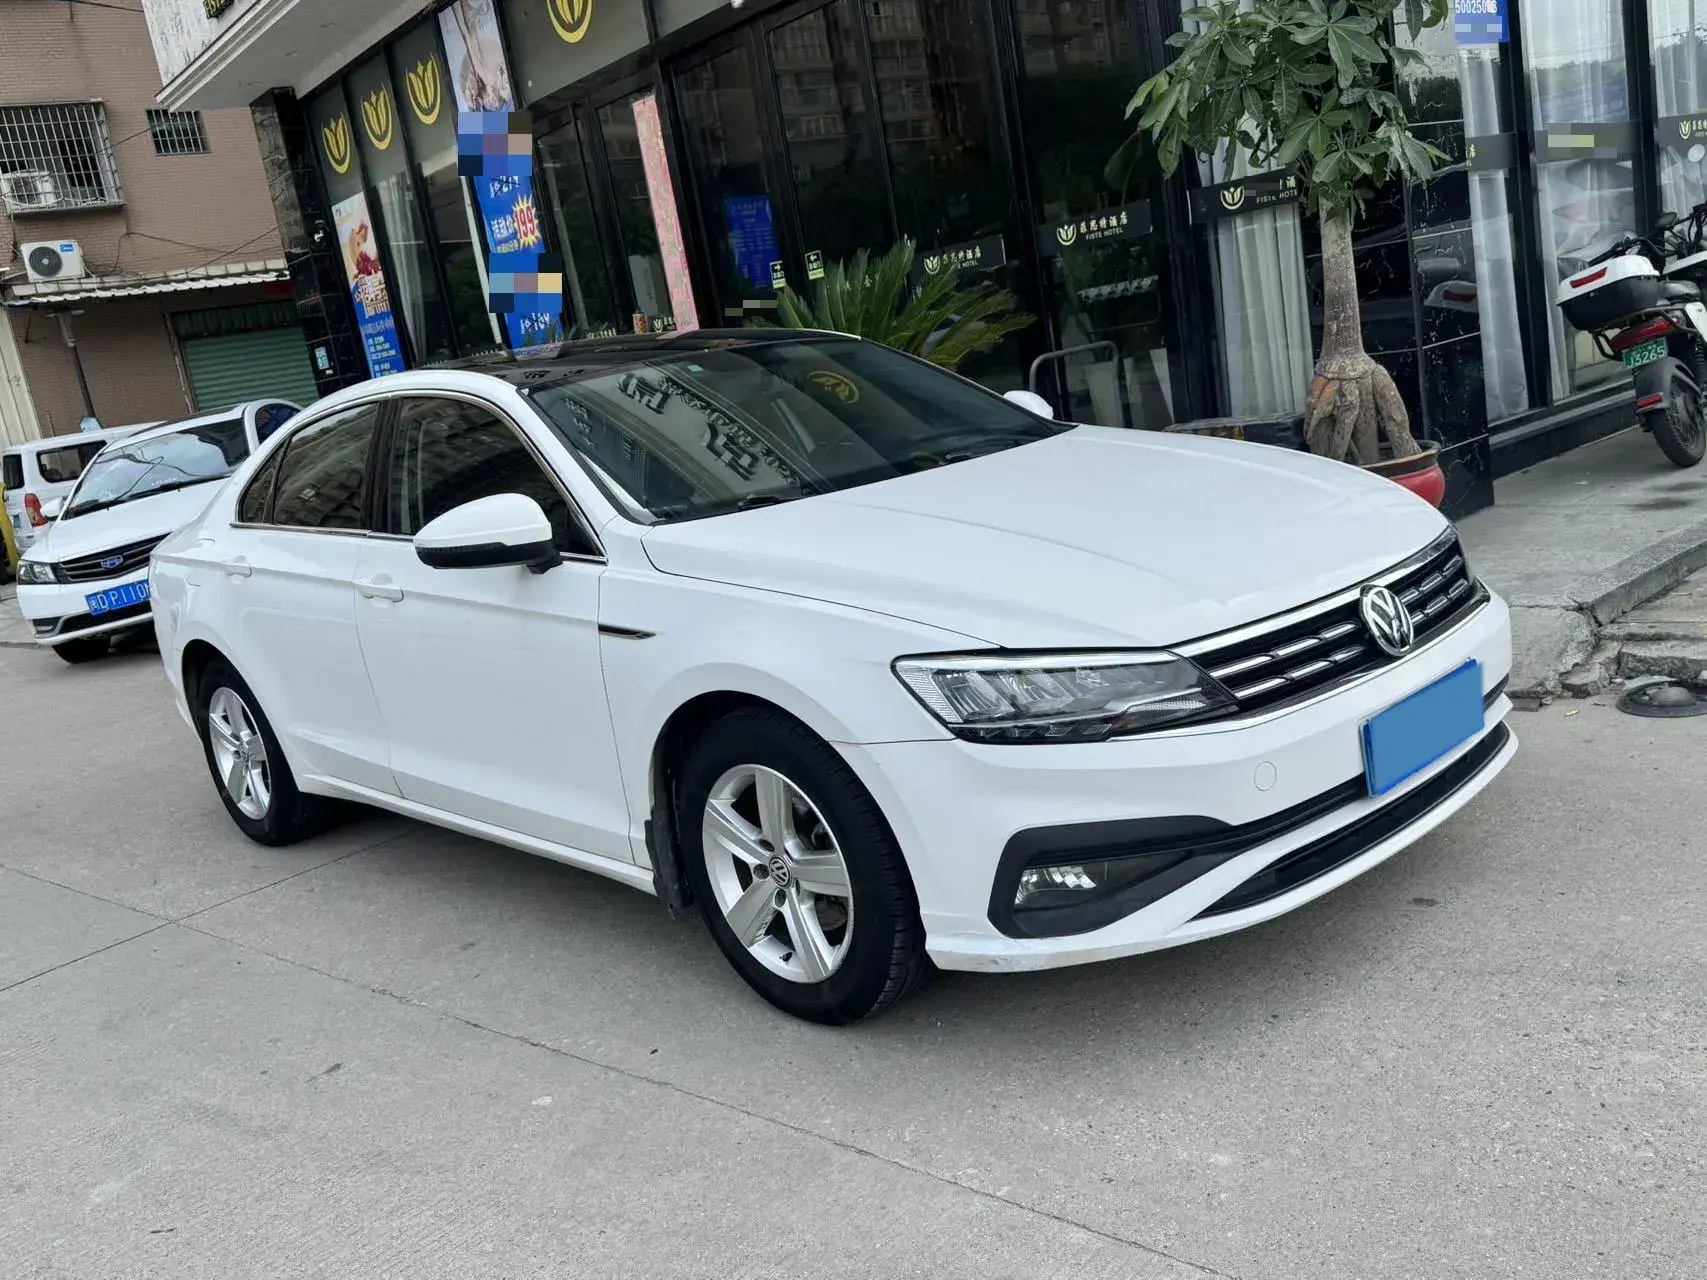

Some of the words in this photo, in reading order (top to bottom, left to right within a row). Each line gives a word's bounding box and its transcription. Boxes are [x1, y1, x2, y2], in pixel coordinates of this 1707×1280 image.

[515, 205, 536, 238] 199
[1085, 232, 1102, 240] FISTE
[1104, 227, 1123, 236] HOTEL
[962, 260, 978, 269] HOTEL
